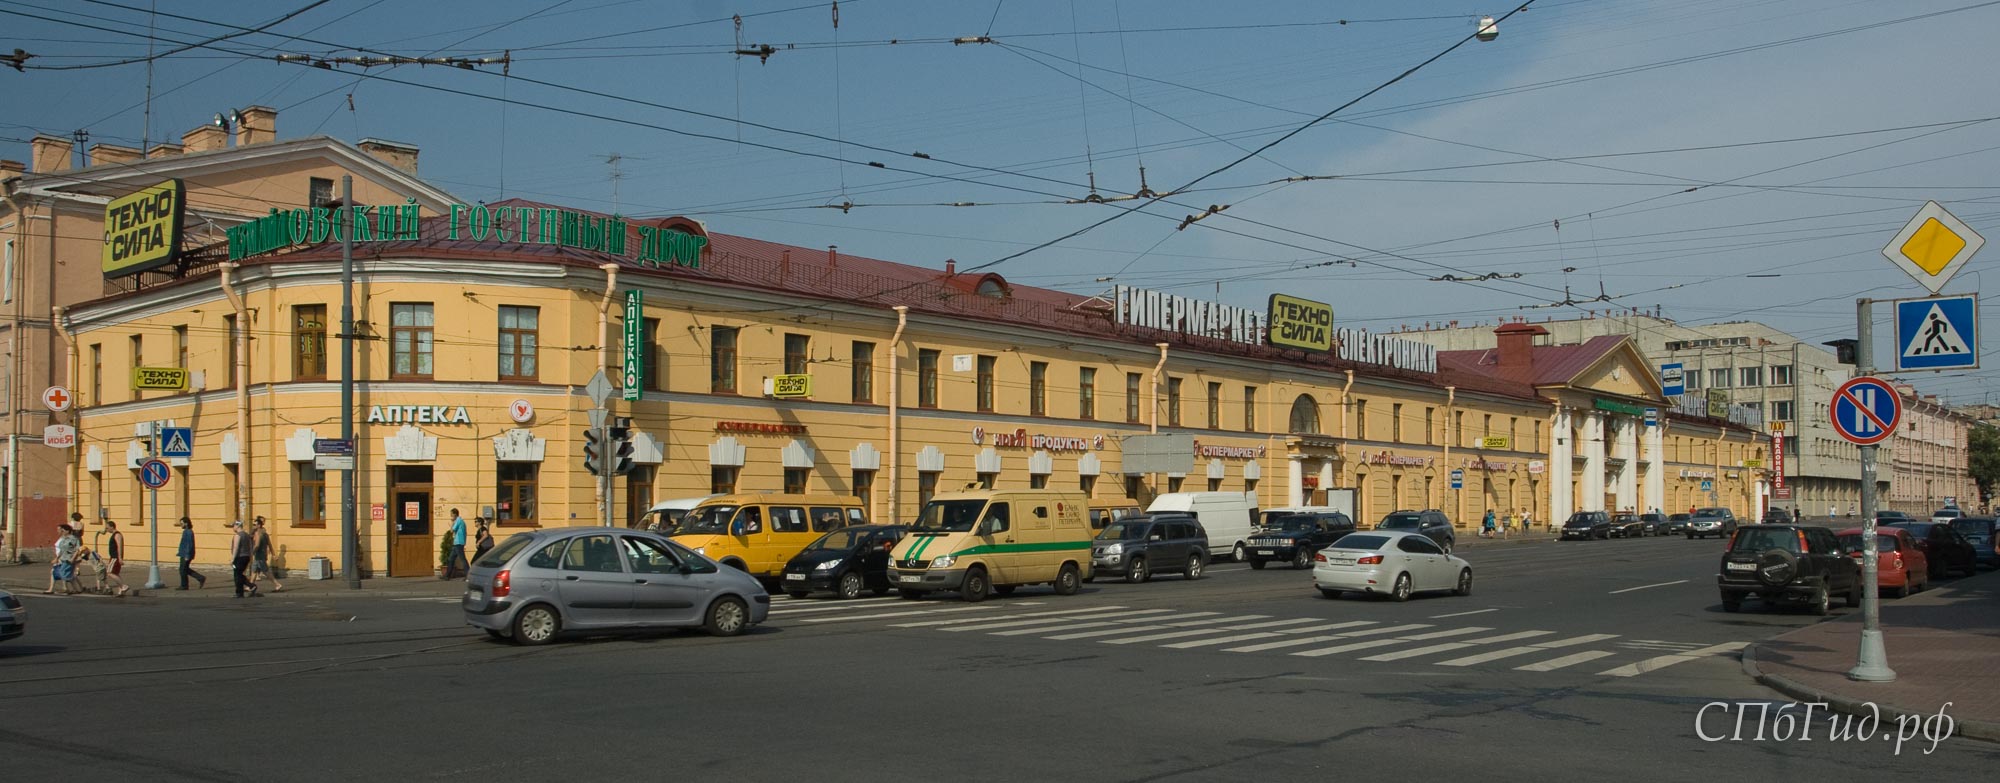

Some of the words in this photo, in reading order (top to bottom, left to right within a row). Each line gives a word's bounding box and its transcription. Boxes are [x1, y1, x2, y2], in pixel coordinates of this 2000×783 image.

[109, 188, 172, 233] ТЕХНО
[112, 222, 164, 261] СИЛА
[448, 203, 627, 256] ГОСТИНЫЙ
[638, 225, 708, 268] ДВОР
[1115, 284, 1267, 346] ГИПЕРМАРКЕТ
[1278, 301, 1330, 326] ТЕХНО
[627, 293, 636, 374] АПТЕКА
[1281, 322, 1325, 345] СИЛА
[1338, 327, 1437, 374] ЭЛЕКТРОНИКИ
[142, 370, 181, 378] ТЕХНО
[367, 405, 471, 424] АПТЕКА
[1031, 435, 1089, 451] ПРОДУКТЫ
[1202, 445, 1258, 458] СУПЕРМАРКЕТ
